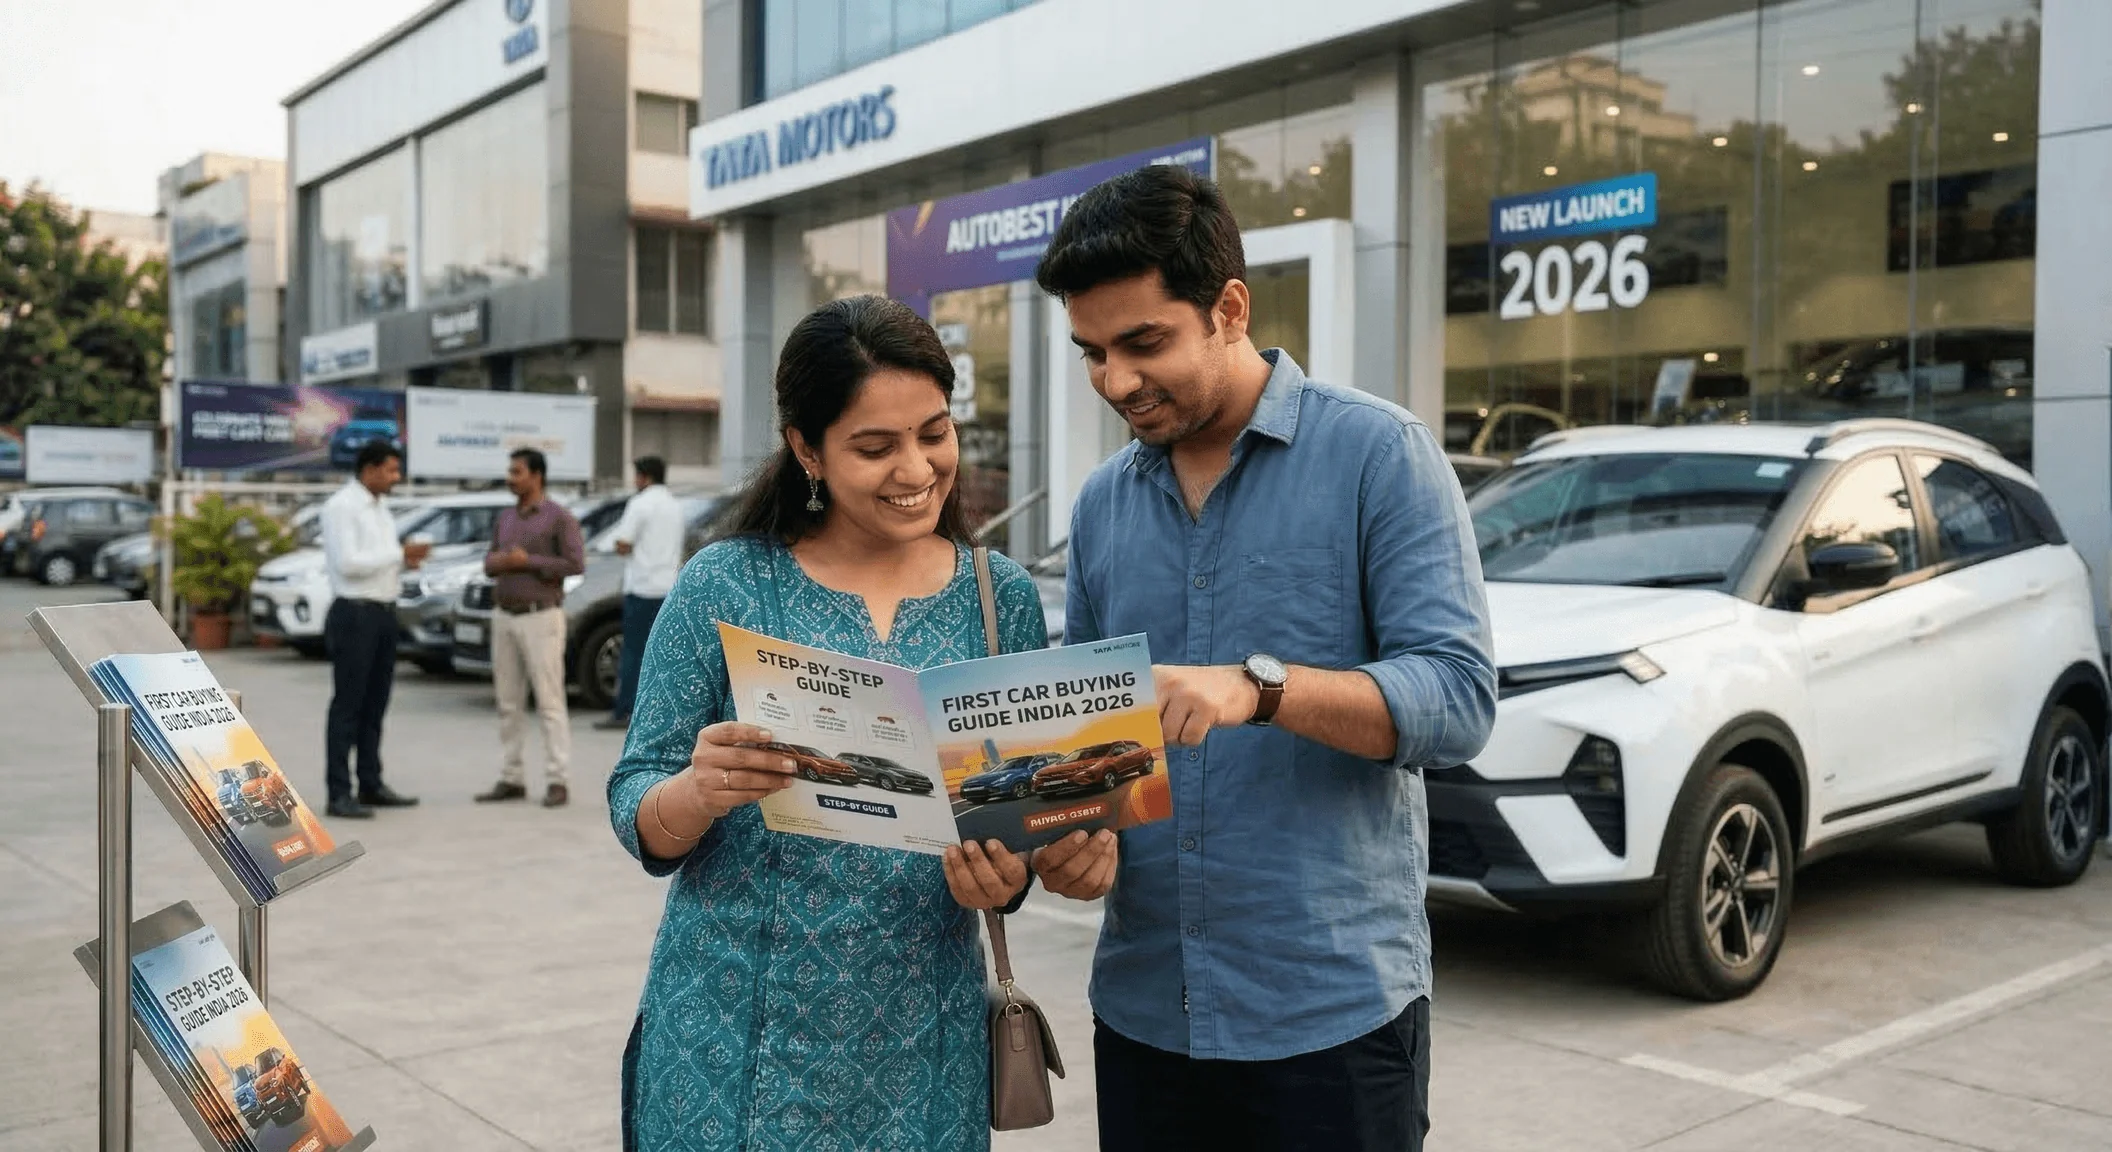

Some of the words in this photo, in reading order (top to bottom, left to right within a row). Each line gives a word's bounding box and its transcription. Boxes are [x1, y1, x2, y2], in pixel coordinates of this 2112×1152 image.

[703, 130, 772, 189] TATA
[779, 85, 896, 168] MOTORS
[947, 202, 1058, 252] AUTOBEST
[1500, 201, 1551, 233] NEW
[1553, 185, 1646, 227] LAUNCH
[1500, 234, 1650, 320] 2026
[757, 649, 884, 688] STEP-BY-STEP
[797, 676, 851, 699] GUIDE
[144, 693, 175, 711] FIRST
[171, 690, 193, 708] CAR
[188, 687, 223, 706] BUYING
[942, 690, 1001, 713] FIRST
[1007, 684, 1050, 703] CAR
[1055, 671, 1136, 697] BUYING
[948, 709, 1012, 733] GUIDE
[1018, 702, 1077, 723] INDIA
[1082, 692, 1134, 714] 2026
[161, 713, 193, 731] GUIDE
[187, 710, 216, 728] INDIA
[211, 706, 236, 723] 2026
[824, 799, 860, 810] STEP-BY
[862, 804, 890, 815] GUIDE
[165, 966, 235, 1012] STEP-BY-STEP
[180, 1007, 210, 1032] GUIDE
[204, 996, 231, 1020] INDIA
[226, 987, 249, 1009] 2026
